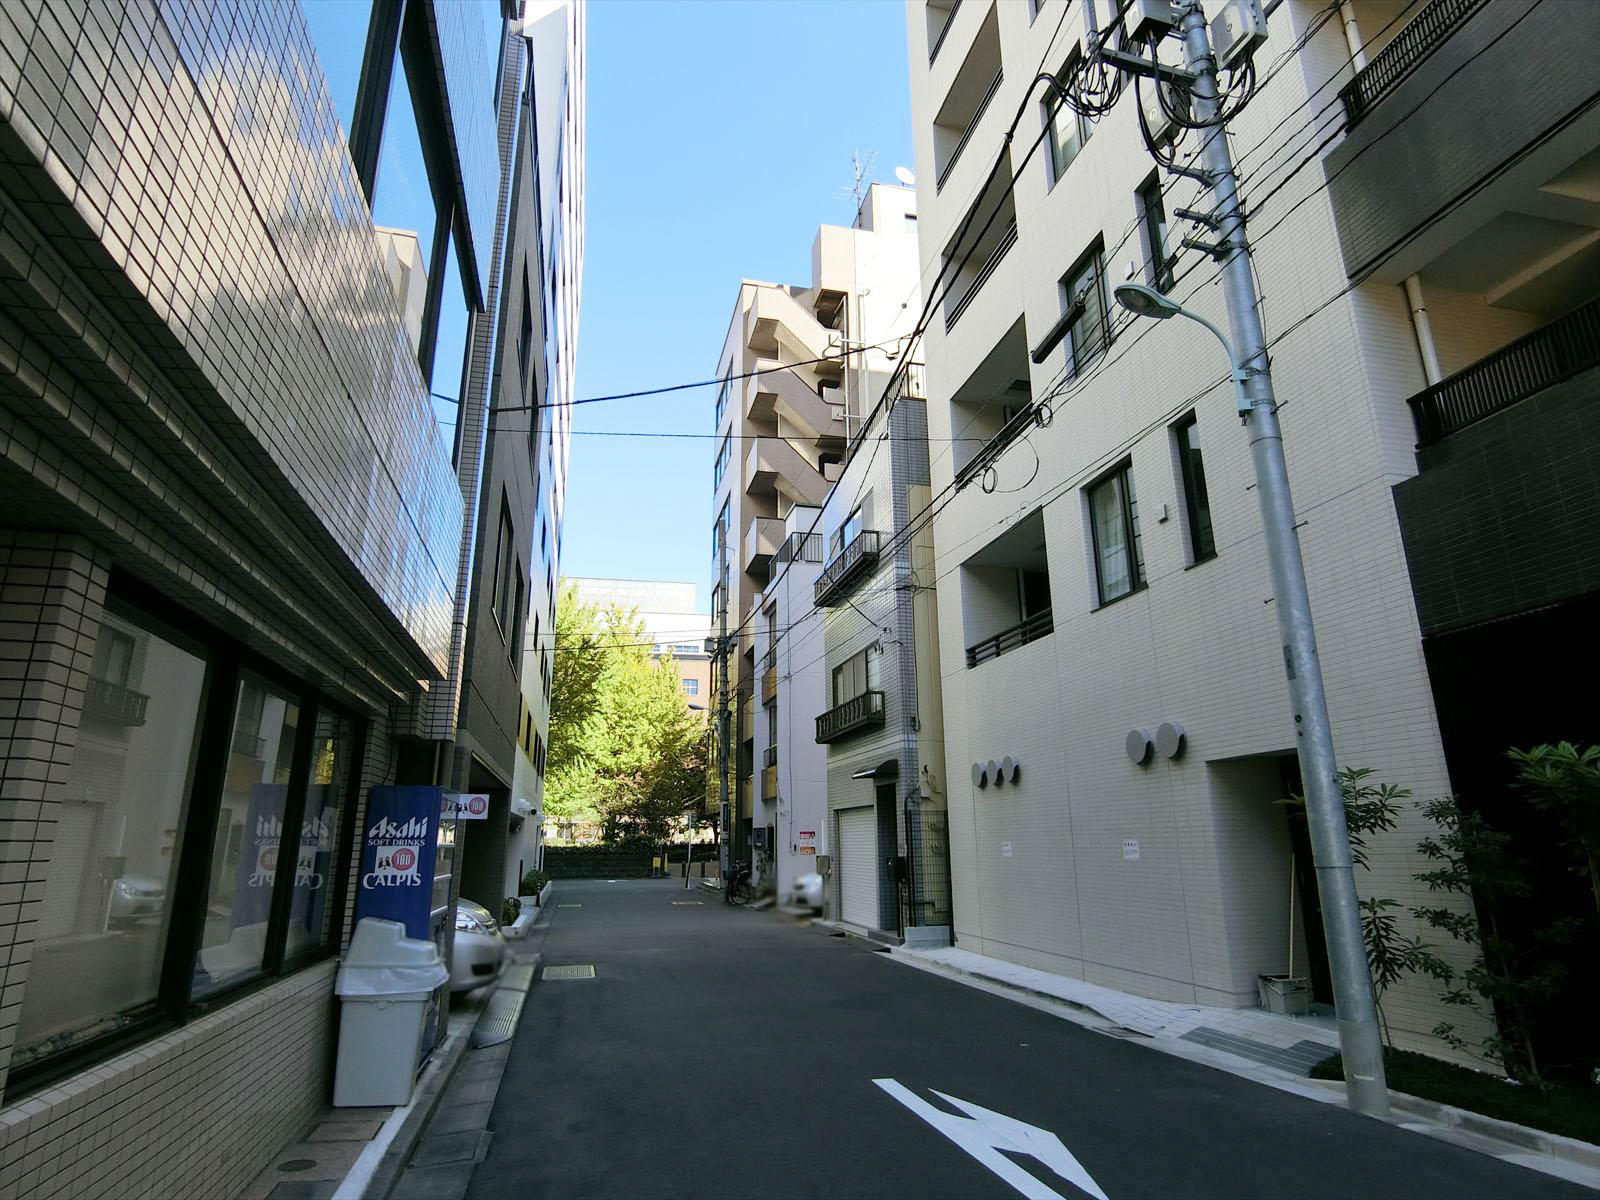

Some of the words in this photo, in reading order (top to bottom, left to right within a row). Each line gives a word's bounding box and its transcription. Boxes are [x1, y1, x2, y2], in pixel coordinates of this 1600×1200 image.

[368, 816, 428, 839] Asahi
[367, 838, 391, 847] SOFT
[392, 838, 426, 847] DRINKS
[396, 853, 411, 865] 100
[362, 873, 422, 889] CALPIS
